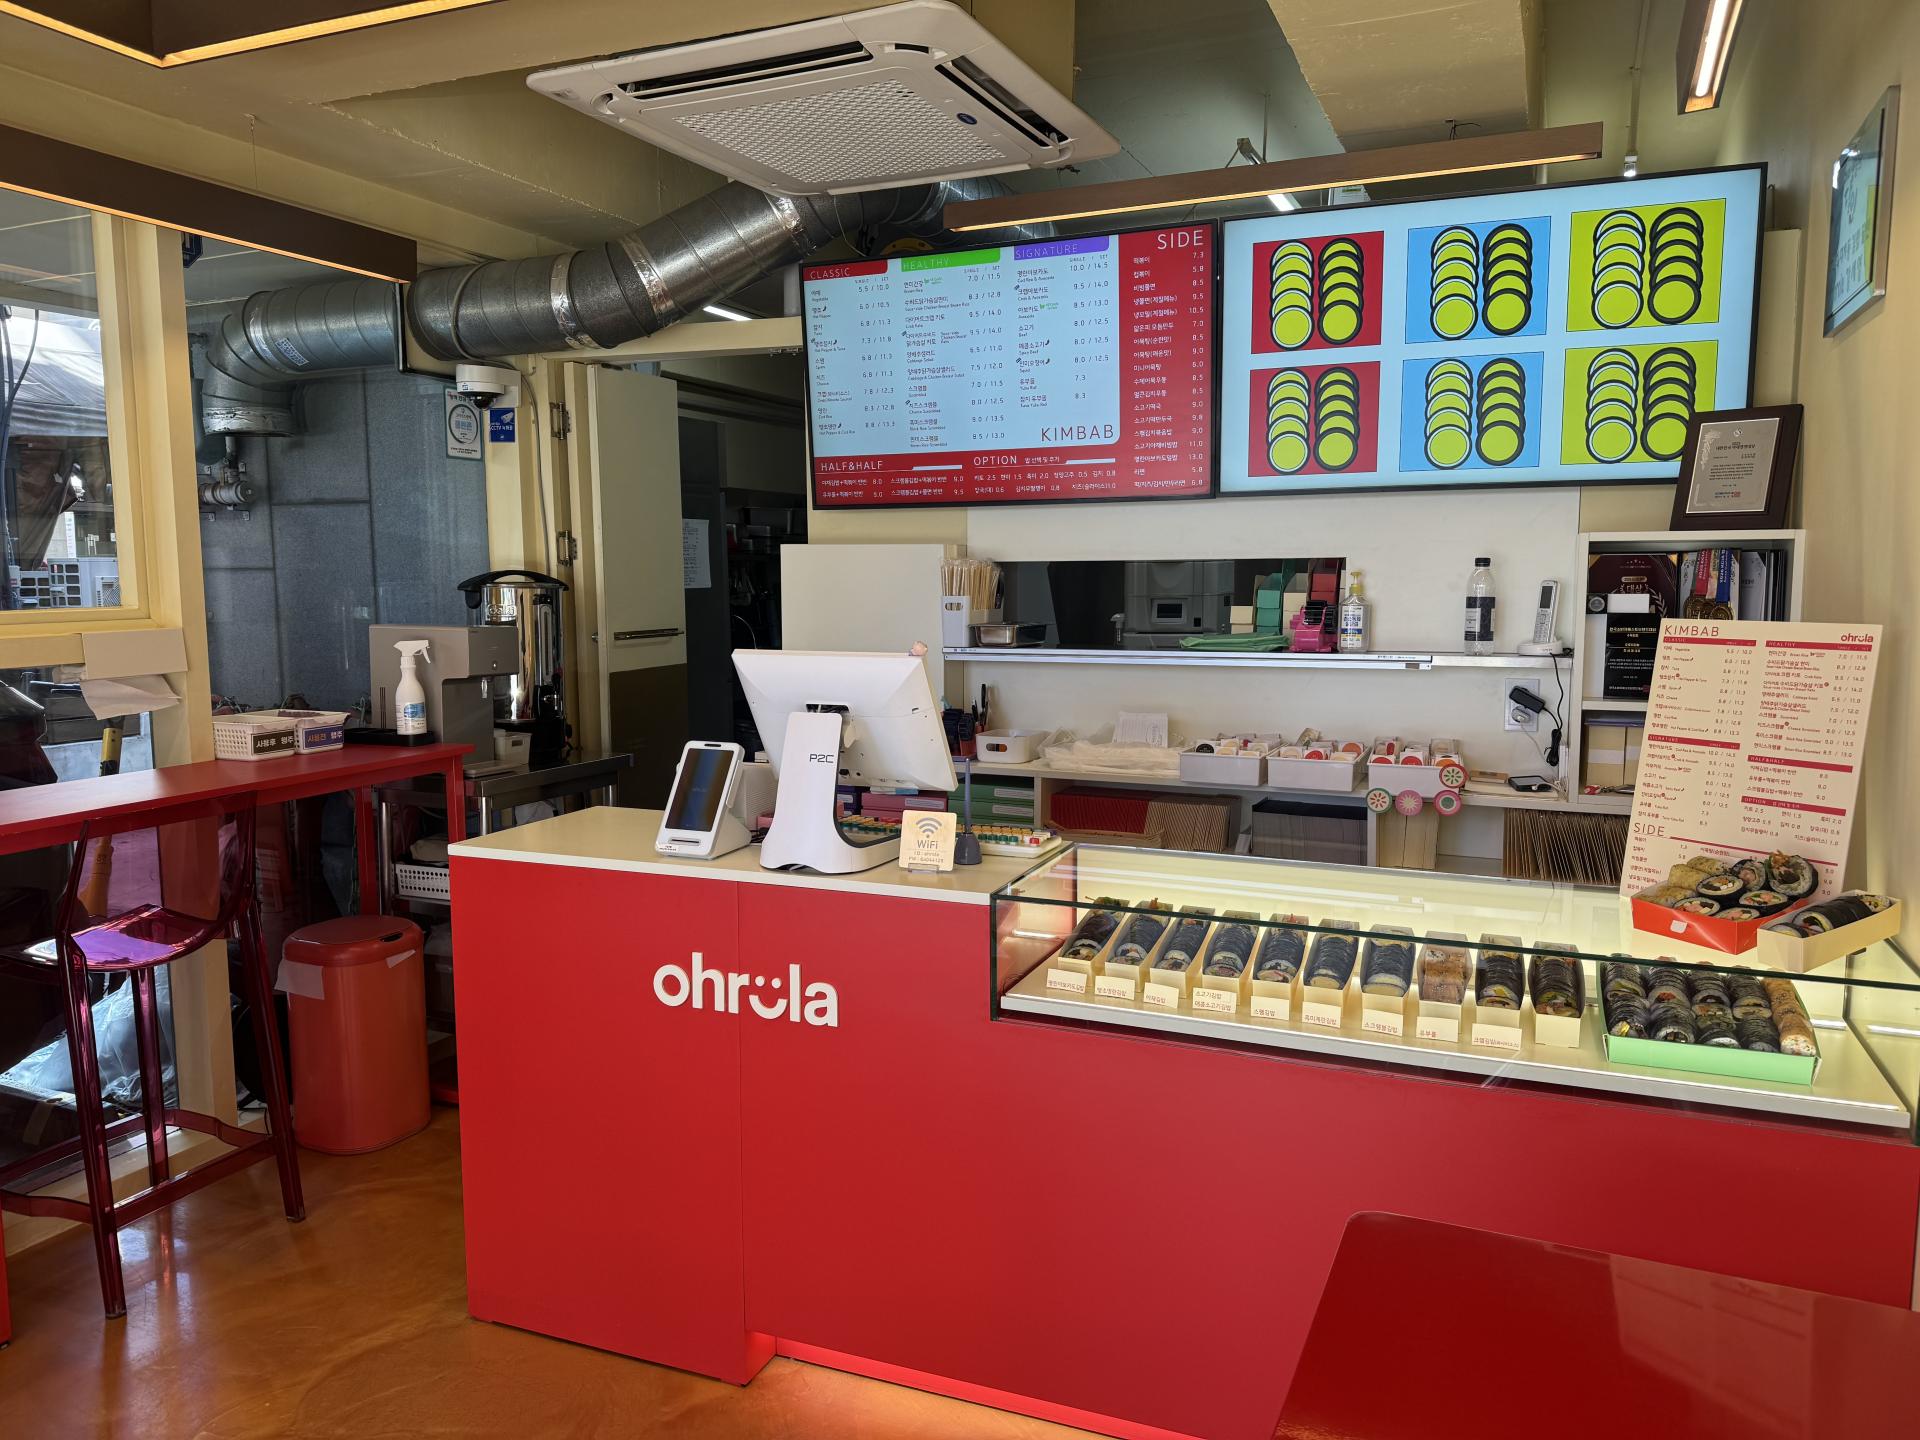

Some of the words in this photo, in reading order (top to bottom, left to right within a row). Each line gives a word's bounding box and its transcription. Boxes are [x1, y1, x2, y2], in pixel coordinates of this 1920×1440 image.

[1157, 230, 1204, 250] SIDE
[1016, 245, 1078, 259] SIGNATURE
[904, 257, 951, 270] HEALTHY
[810, 267, 851, 280] CLASSIC
[1041, 424, 1114, 442] KIMBAB
[821, 460, 883, 471] HALF&HALF
[974, 456, 1017, 466] OPTION
[1664, 624, 1719, 637] KIMBAB
[809, 753, 835, 763] P2C
[1633, 823, 1665, 837] SIDE
[917, 839, 939, 849] WiFi
[1195, 990, 1222, 1000] 소고기김밥
